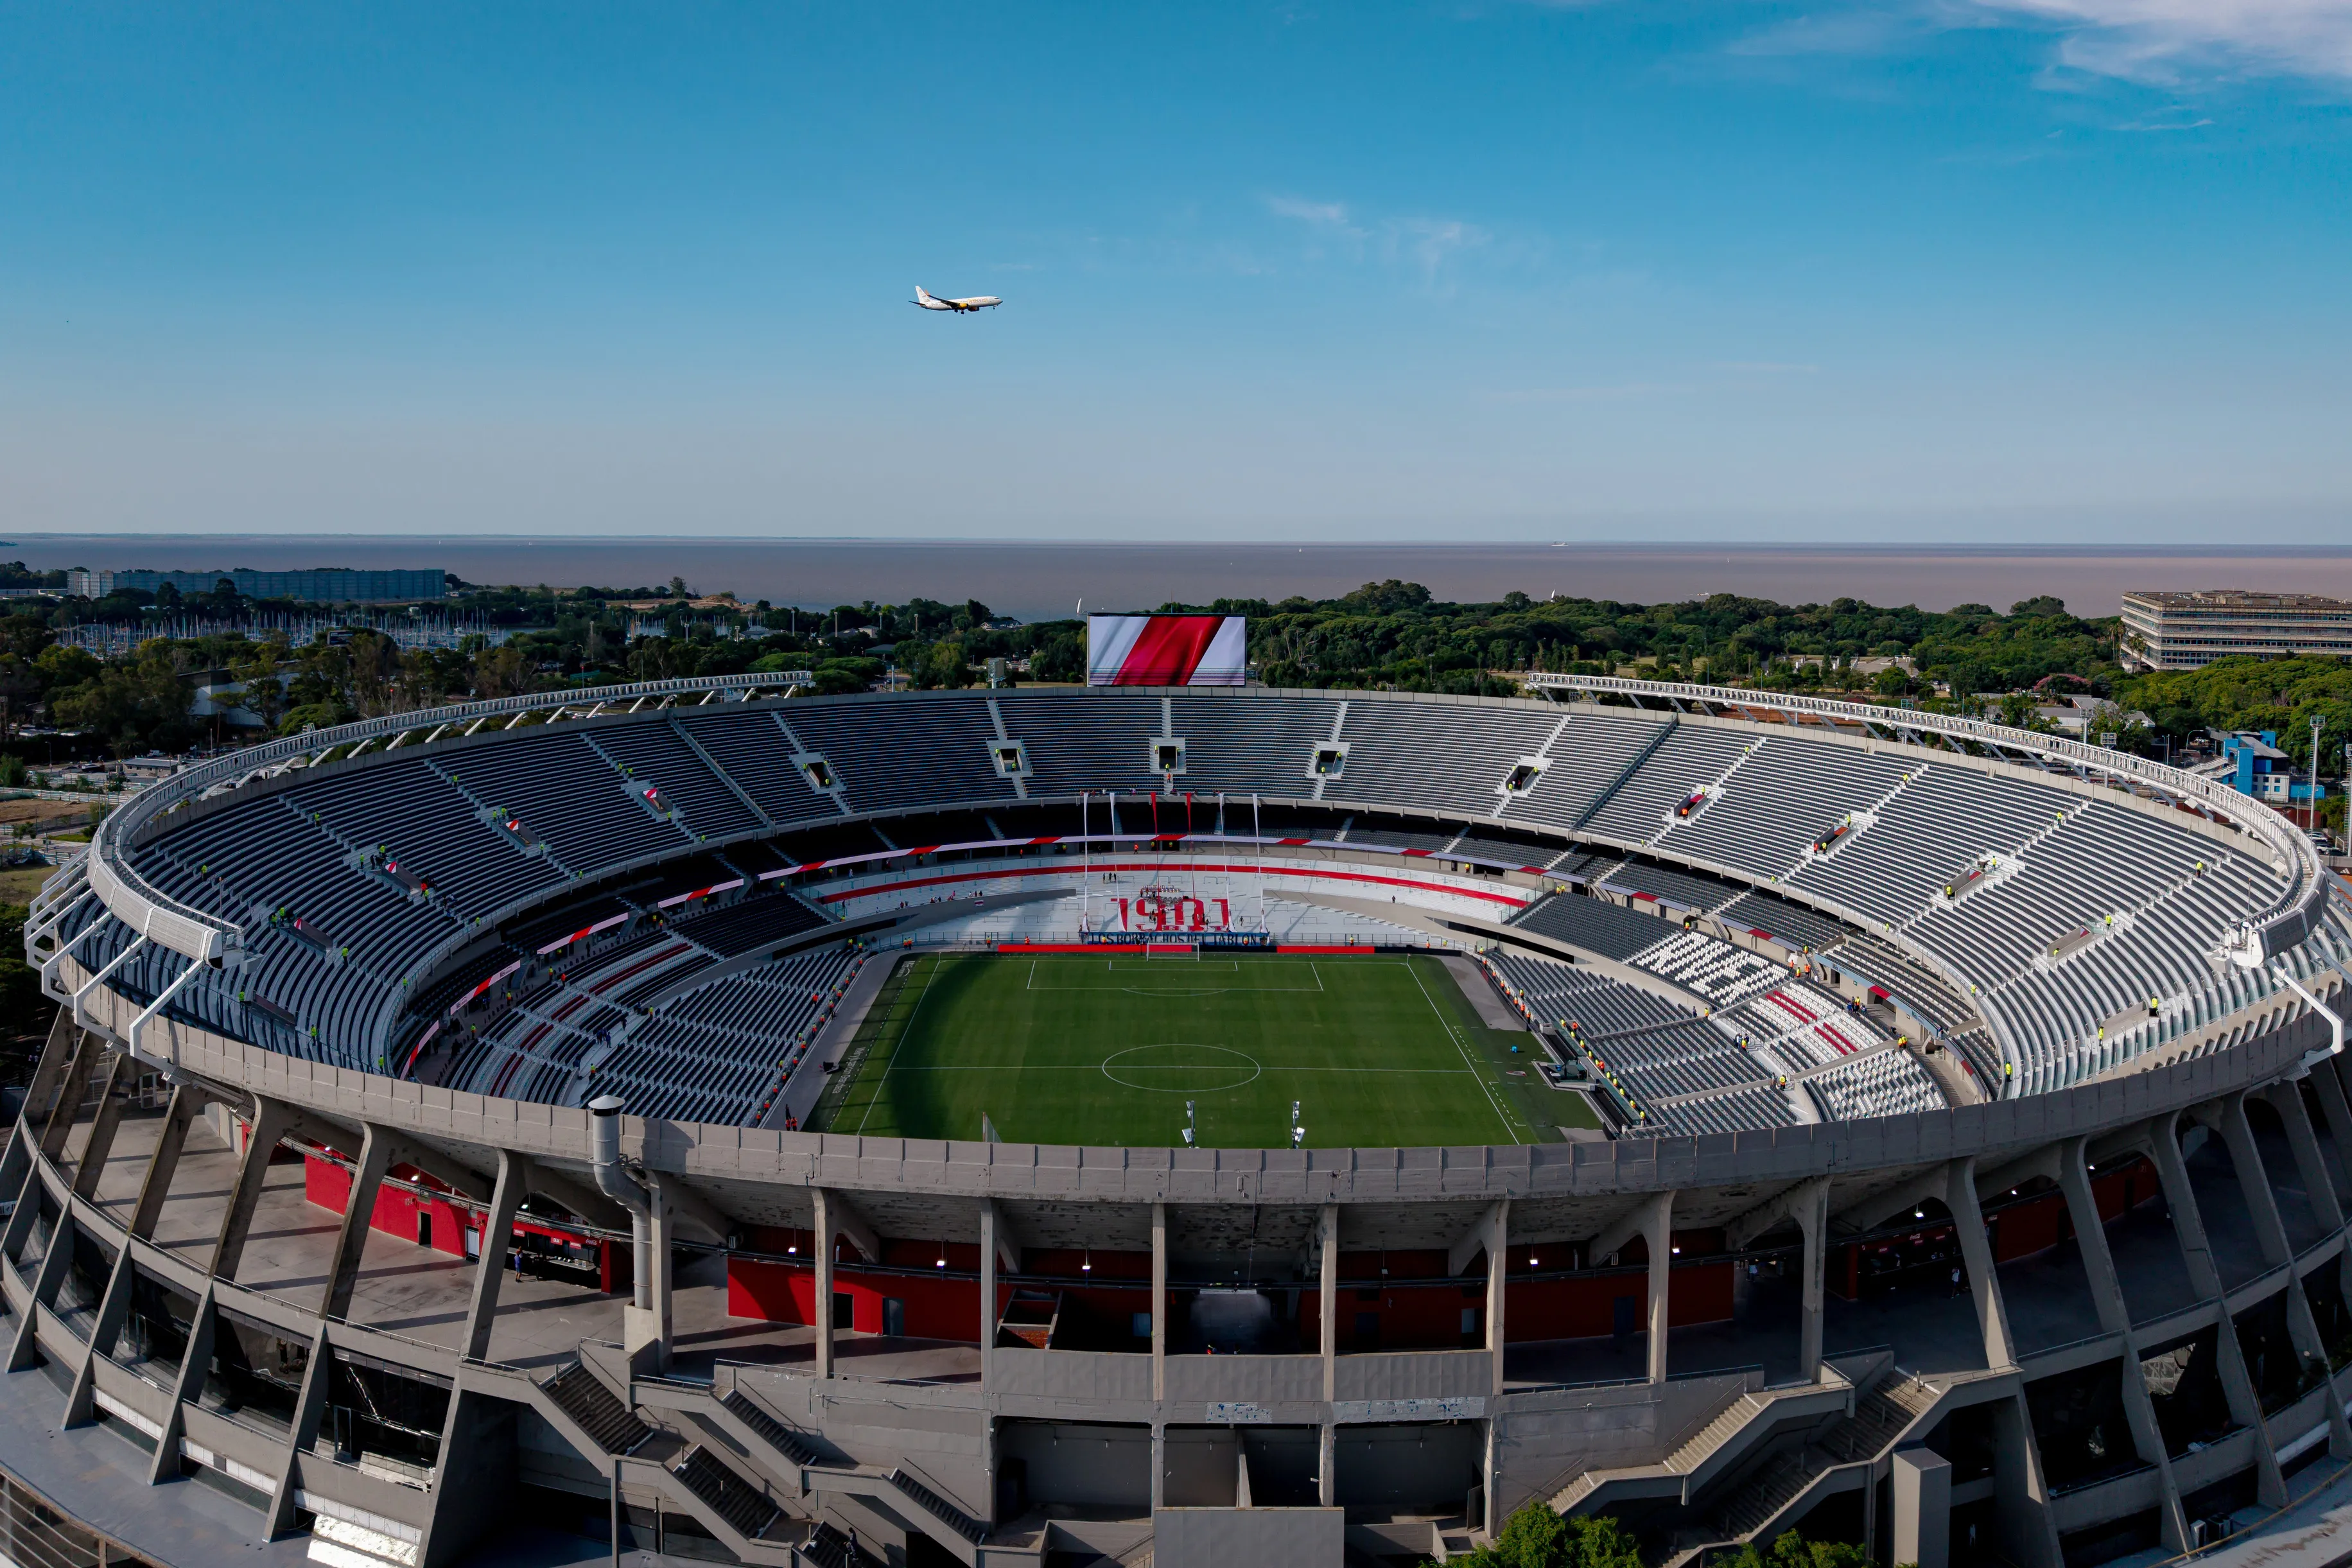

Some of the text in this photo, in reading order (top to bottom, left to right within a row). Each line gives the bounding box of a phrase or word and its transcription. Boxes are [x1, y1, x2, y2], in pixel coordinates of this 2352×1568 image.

[1111, 898, 1229, 932] 1901
[1091, 932, 1257, 946] LOS BORRACHOS DEL TABLON
[1637, 932, 1789, 1006] RIVER
